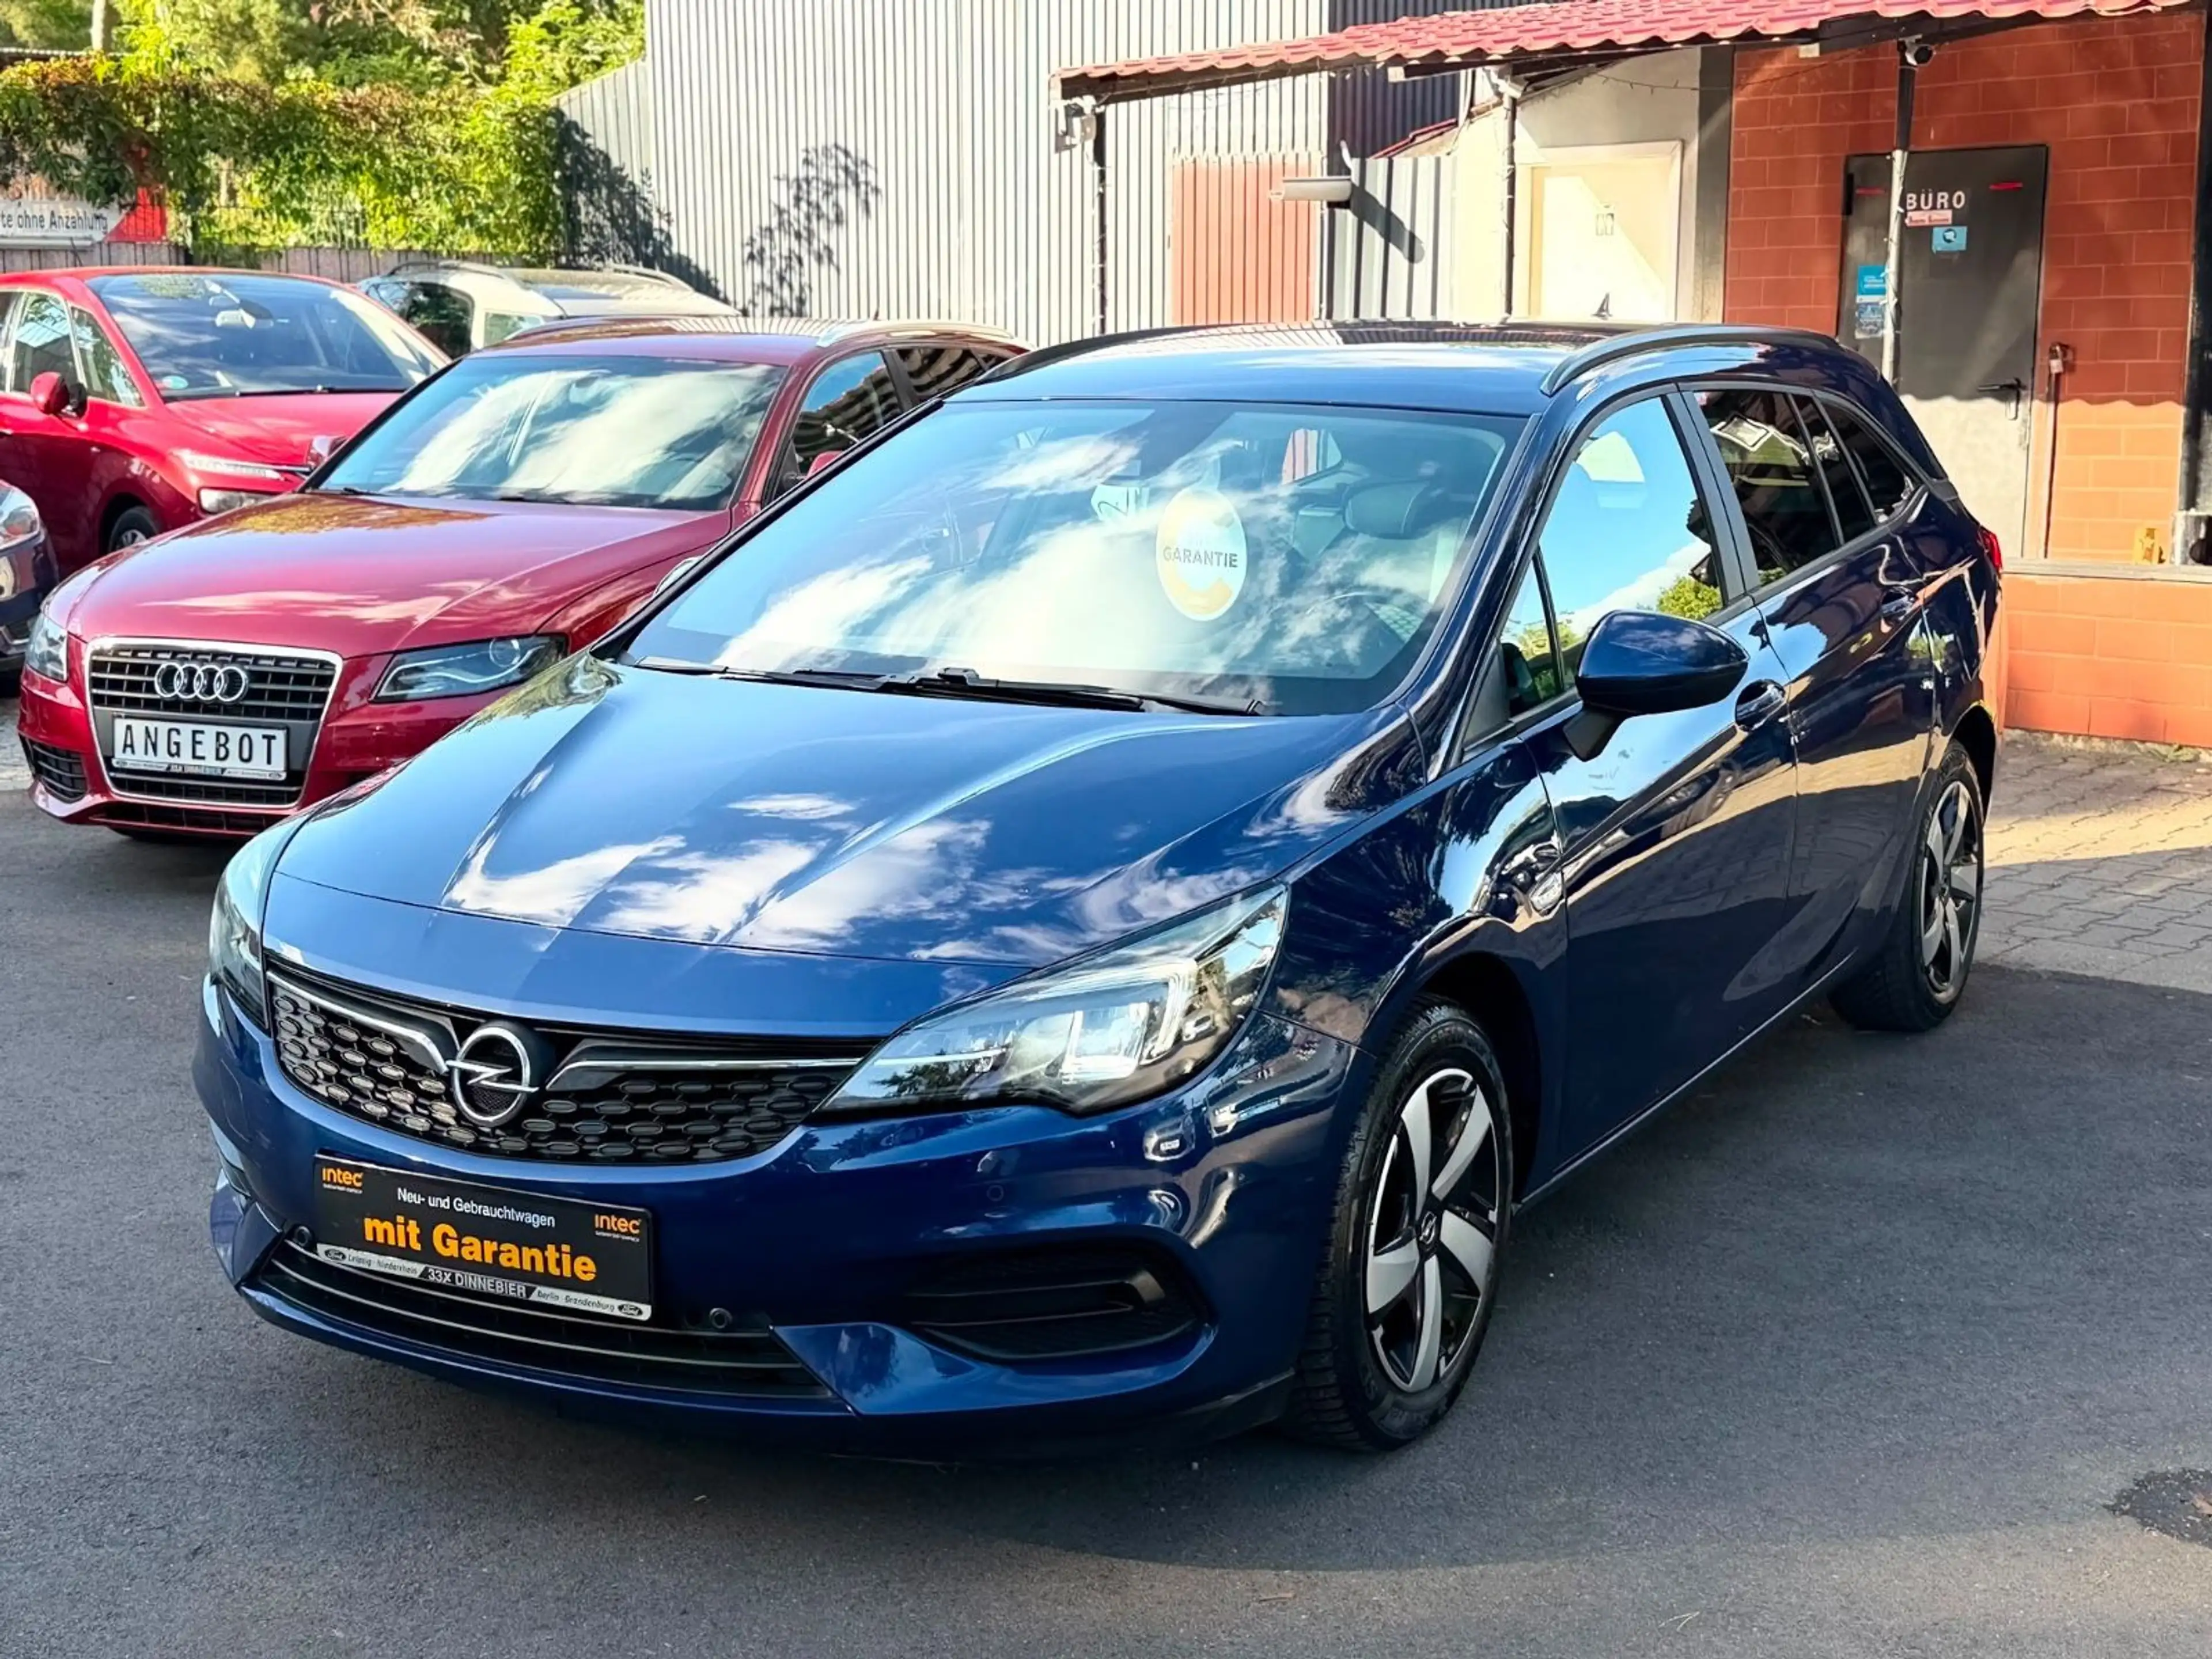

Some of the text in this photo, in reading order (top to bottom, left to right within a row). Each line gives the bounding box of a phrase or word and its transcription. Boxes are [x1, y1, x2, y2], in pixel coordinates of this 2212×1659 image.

[1906, 188, 1965, 210] BÜRO
[17, 209, 45, 229] ohne
[50, 210, 108, 234] Anzahlung
[1163, 546, 1238, 567] GARANTIE
[122, 724, 276, 766] ANGEBOT
[321, 1167, 364, 1187] intec
[397, 1187, 555, 1228] Neu- und Gebrauchtwagen
[594, 1214, 641, 1234] intec
[363, 1215, 597, 1282] mit Garantie
[454, 1272, 526, 1298] DINNEBIER
